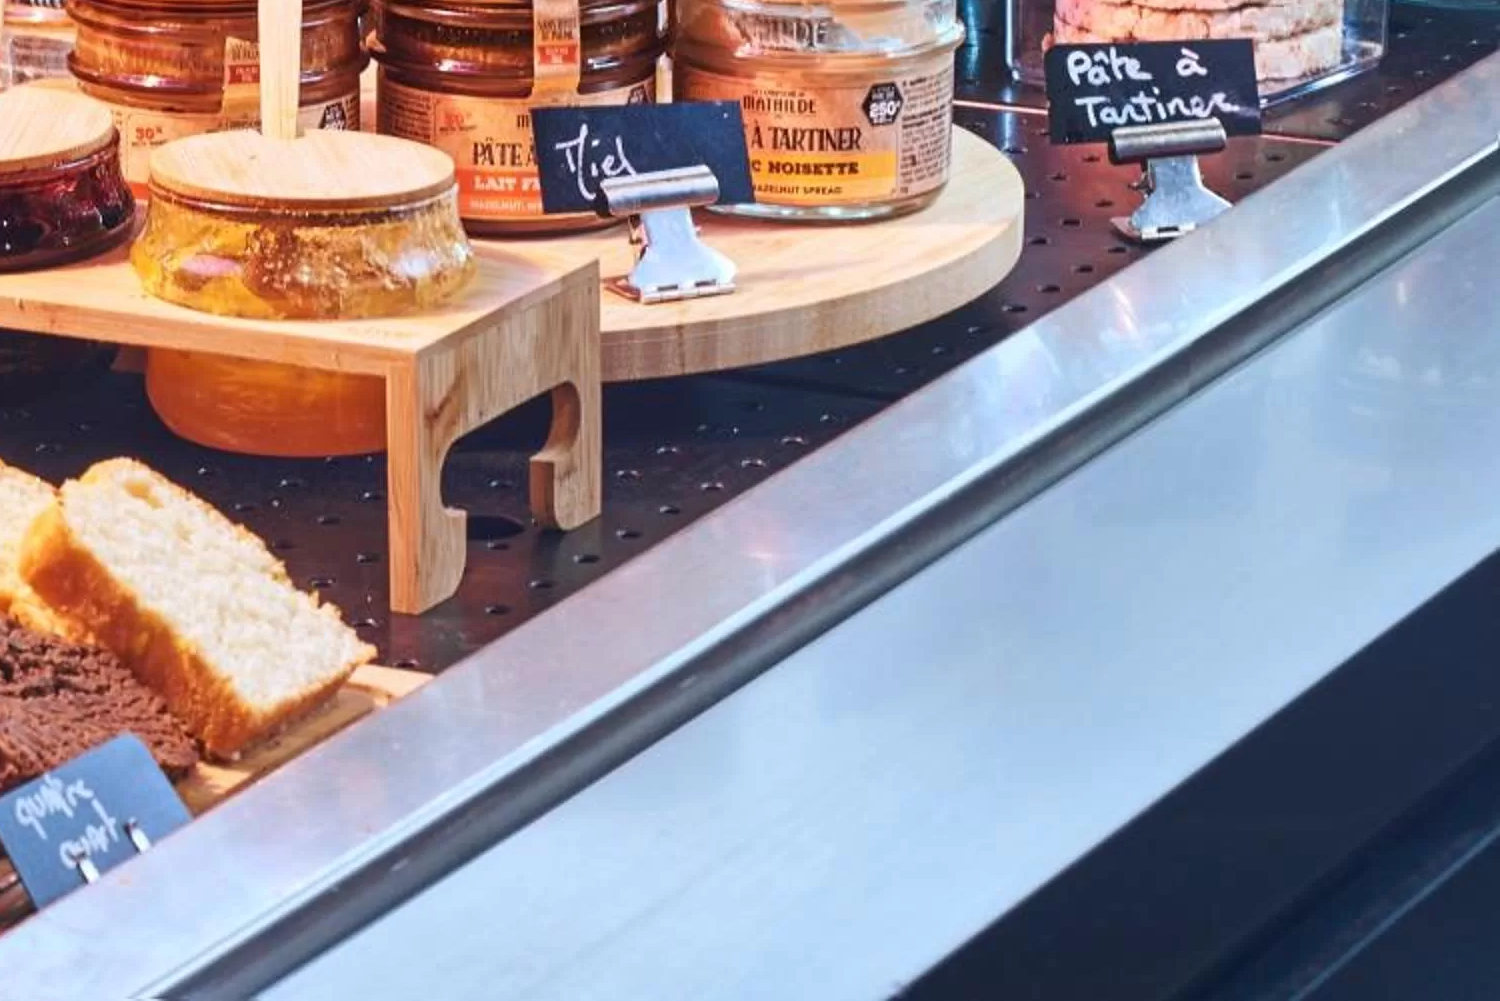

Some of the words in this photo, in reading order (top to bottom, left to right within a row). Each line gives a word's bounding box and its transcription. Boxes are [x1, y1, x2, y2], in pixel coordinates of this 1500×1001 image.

[1066, 46, 1153, 87] Pâte
[1175, 47, 1209, 77] à
[742, 95, 817, 114] MATHILDE
[767, 125, 863, 152] TARTINER
[767, 160, 860, 176] NOISETTE
